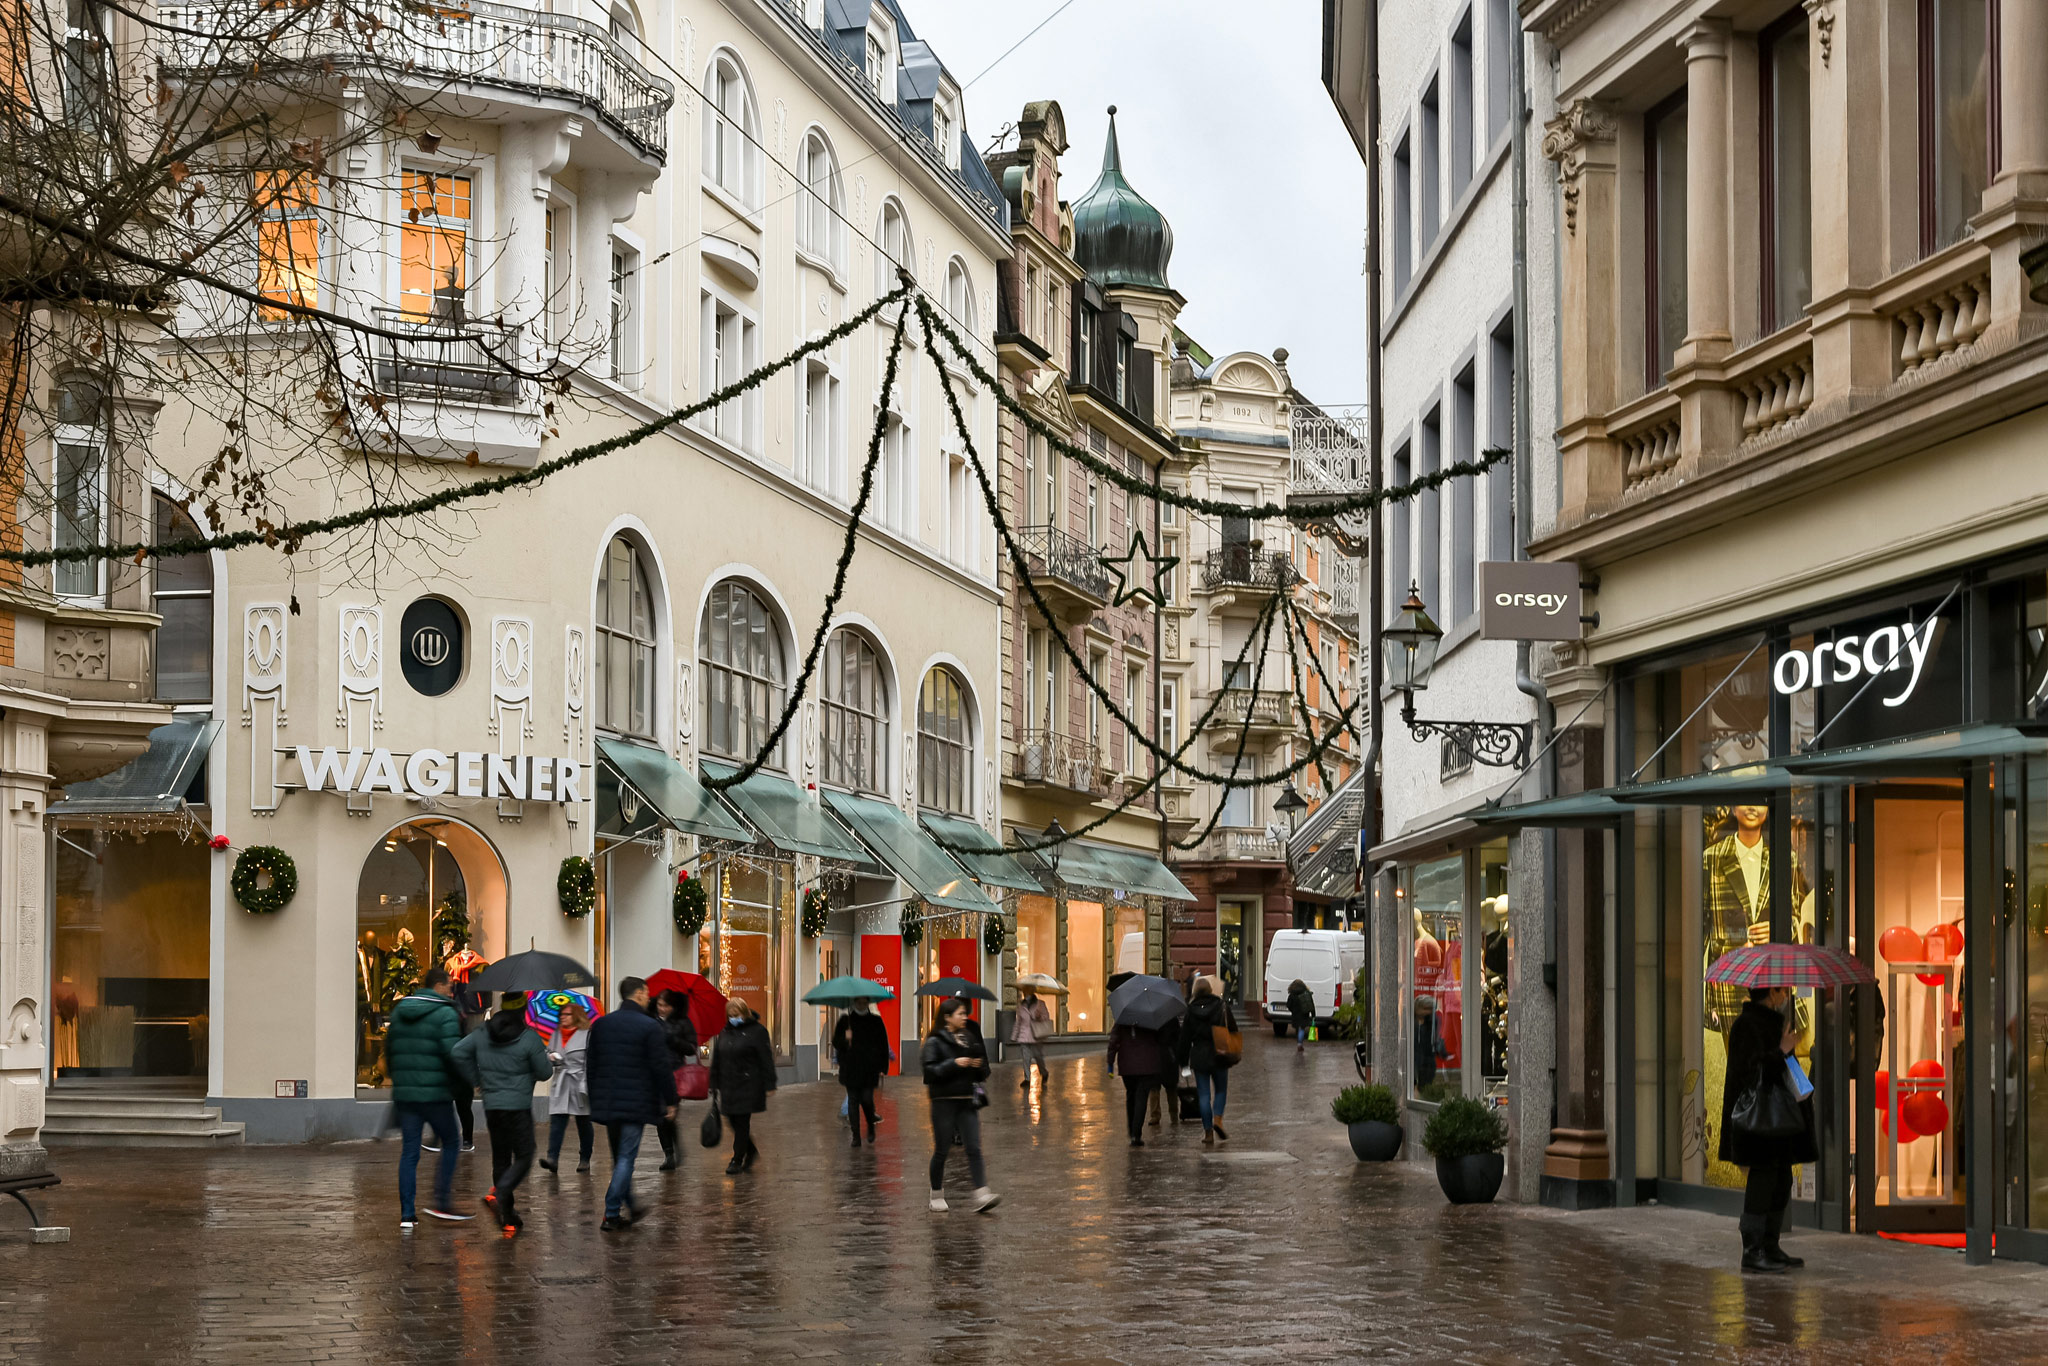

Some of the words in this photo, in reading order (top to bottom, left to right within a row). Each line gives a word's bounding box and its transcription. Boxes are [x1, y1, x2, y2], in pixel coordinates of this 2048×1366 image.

[1495, 593, 1568, 616] orsay
[1773, 615, 1938, 708] orsay
[295, 745, 584, 802] WAGENER
